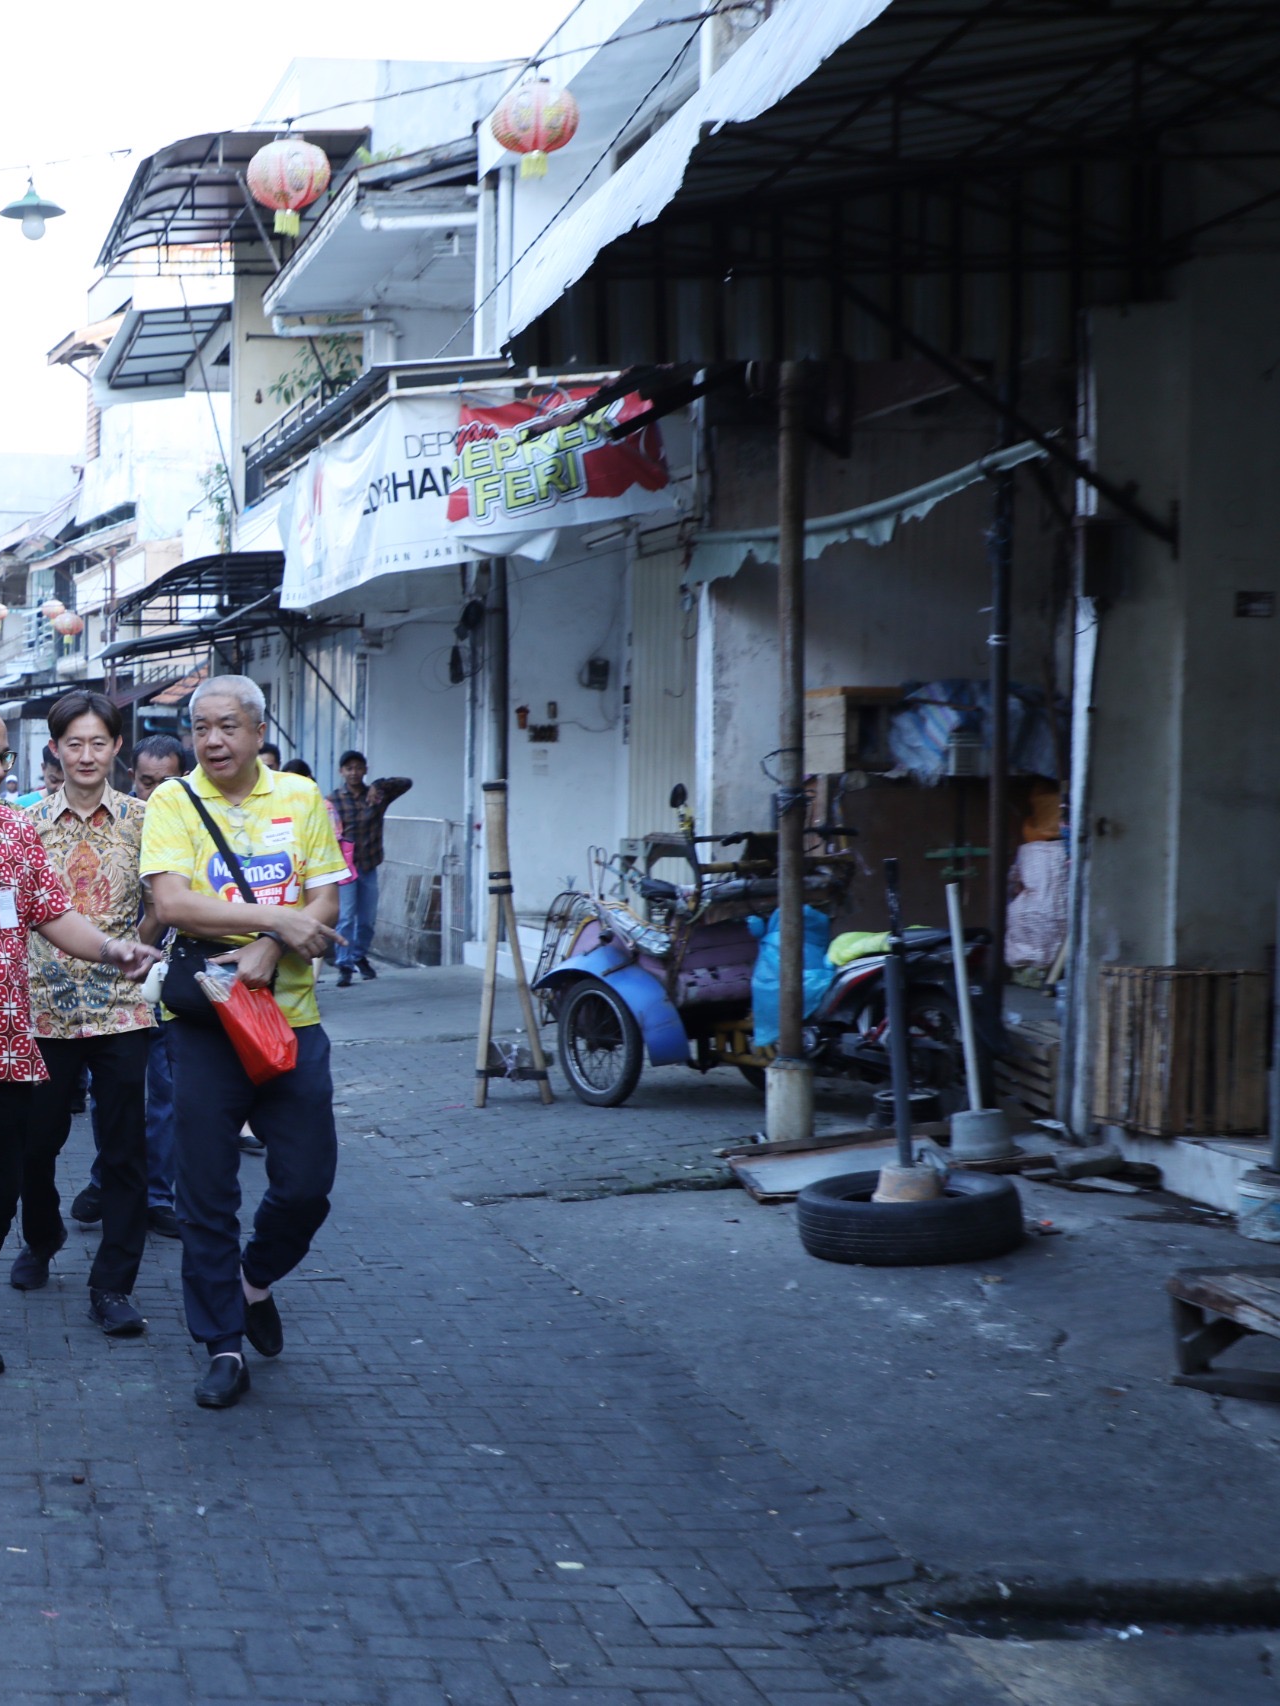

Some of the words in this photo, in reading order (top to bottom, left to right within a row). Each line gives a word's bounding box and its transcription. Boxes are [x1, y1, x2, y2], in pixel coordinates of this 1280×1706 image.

[474, 451, 579, 517] FERI
[213, 858, 286, 883] Mimas
[254, 887, 282, 897] LEBIH
